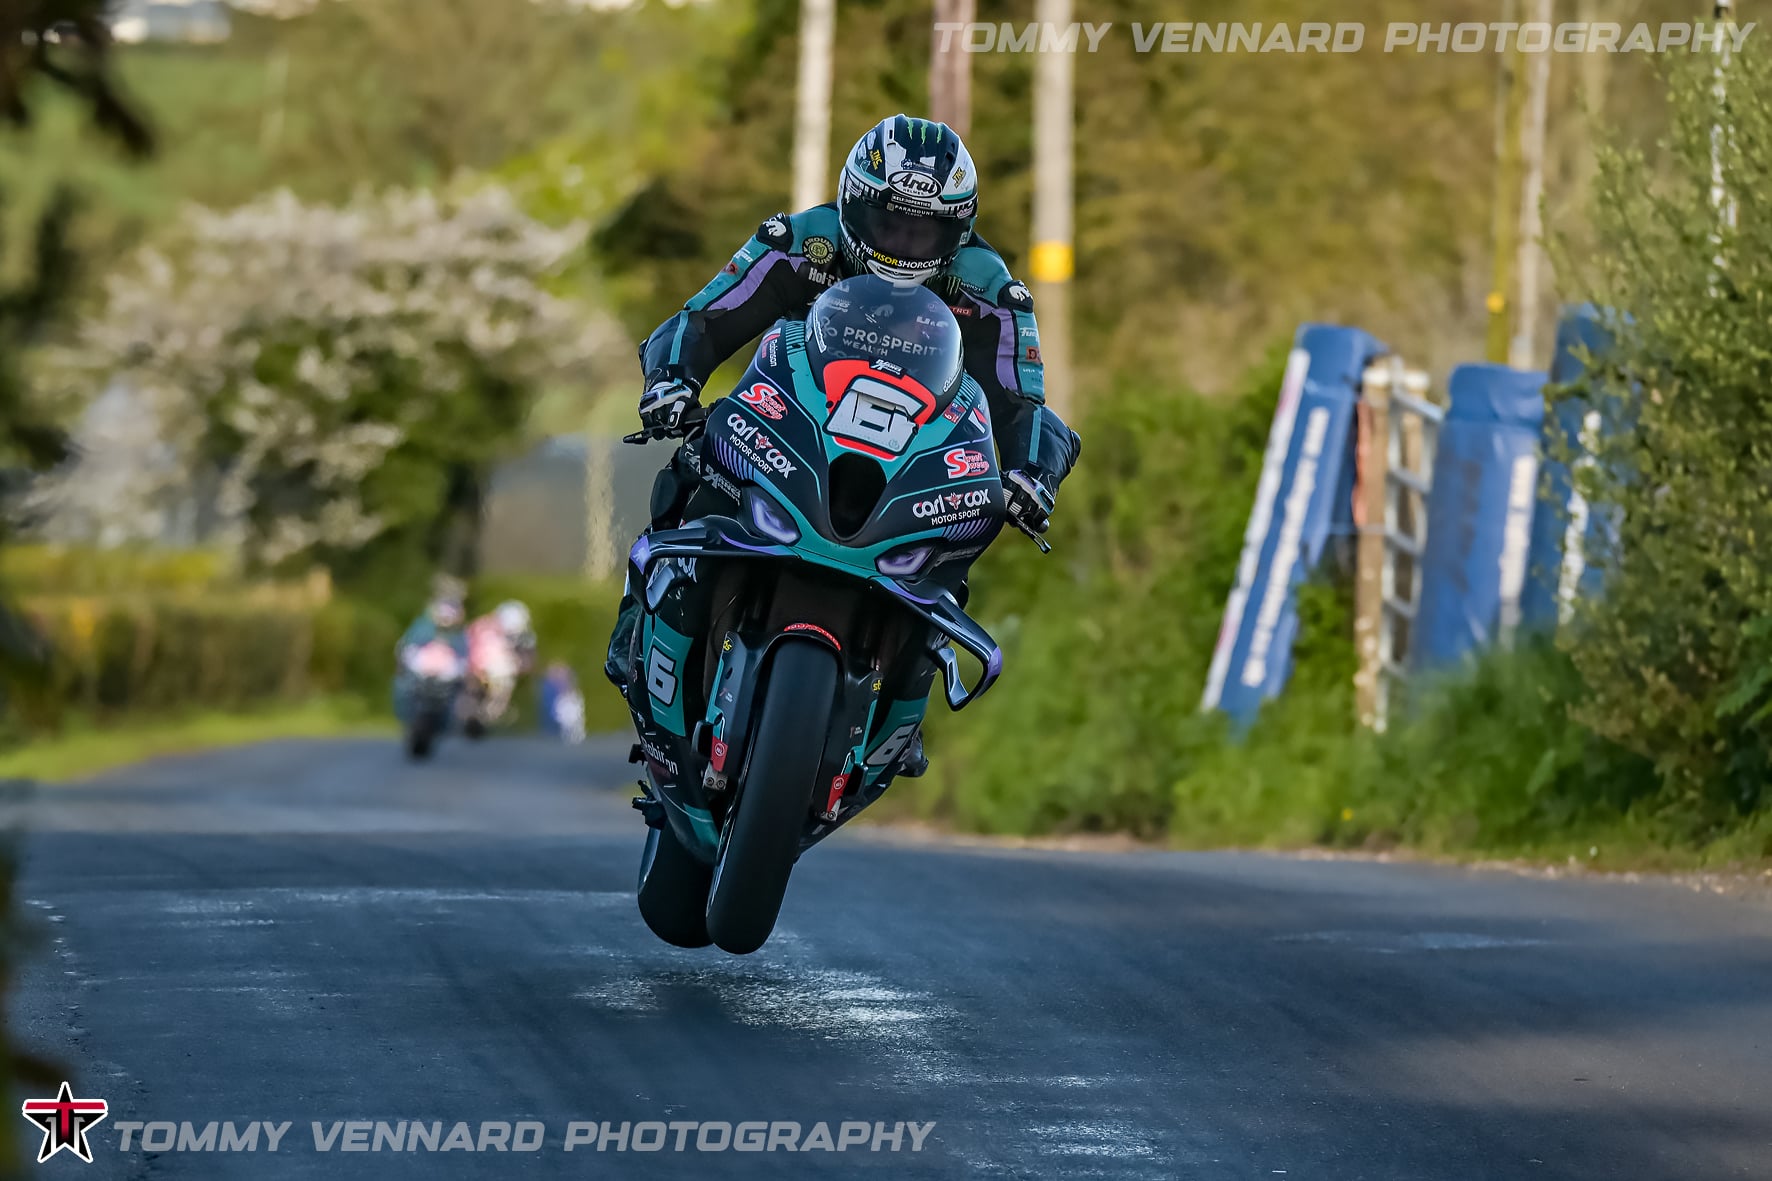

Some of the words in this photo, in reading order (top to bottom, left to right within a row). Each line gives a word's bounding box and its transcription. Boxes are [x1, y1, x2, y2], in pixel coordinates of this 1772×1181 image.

[891, 173, 936, 193] Arai
[894, 204, 934, 216] PARAMOUNT
[842, 338, 888, 356] WEALTH
[824, 376, 926, 454] 6
[727, 413, 758, 442] carl
[765, 448, 797, 479] cox
[729, 434, 752, 457] MOTOR
[750, 451, 773, 475] SPORT
[912, 495, 946, 518] carl
[964, 488, 991, 507] cox
[931, 512, 957, 525] MOTOR
[958, 508, 980, 520] SPORT
[647, 646, 677, 706] 6
